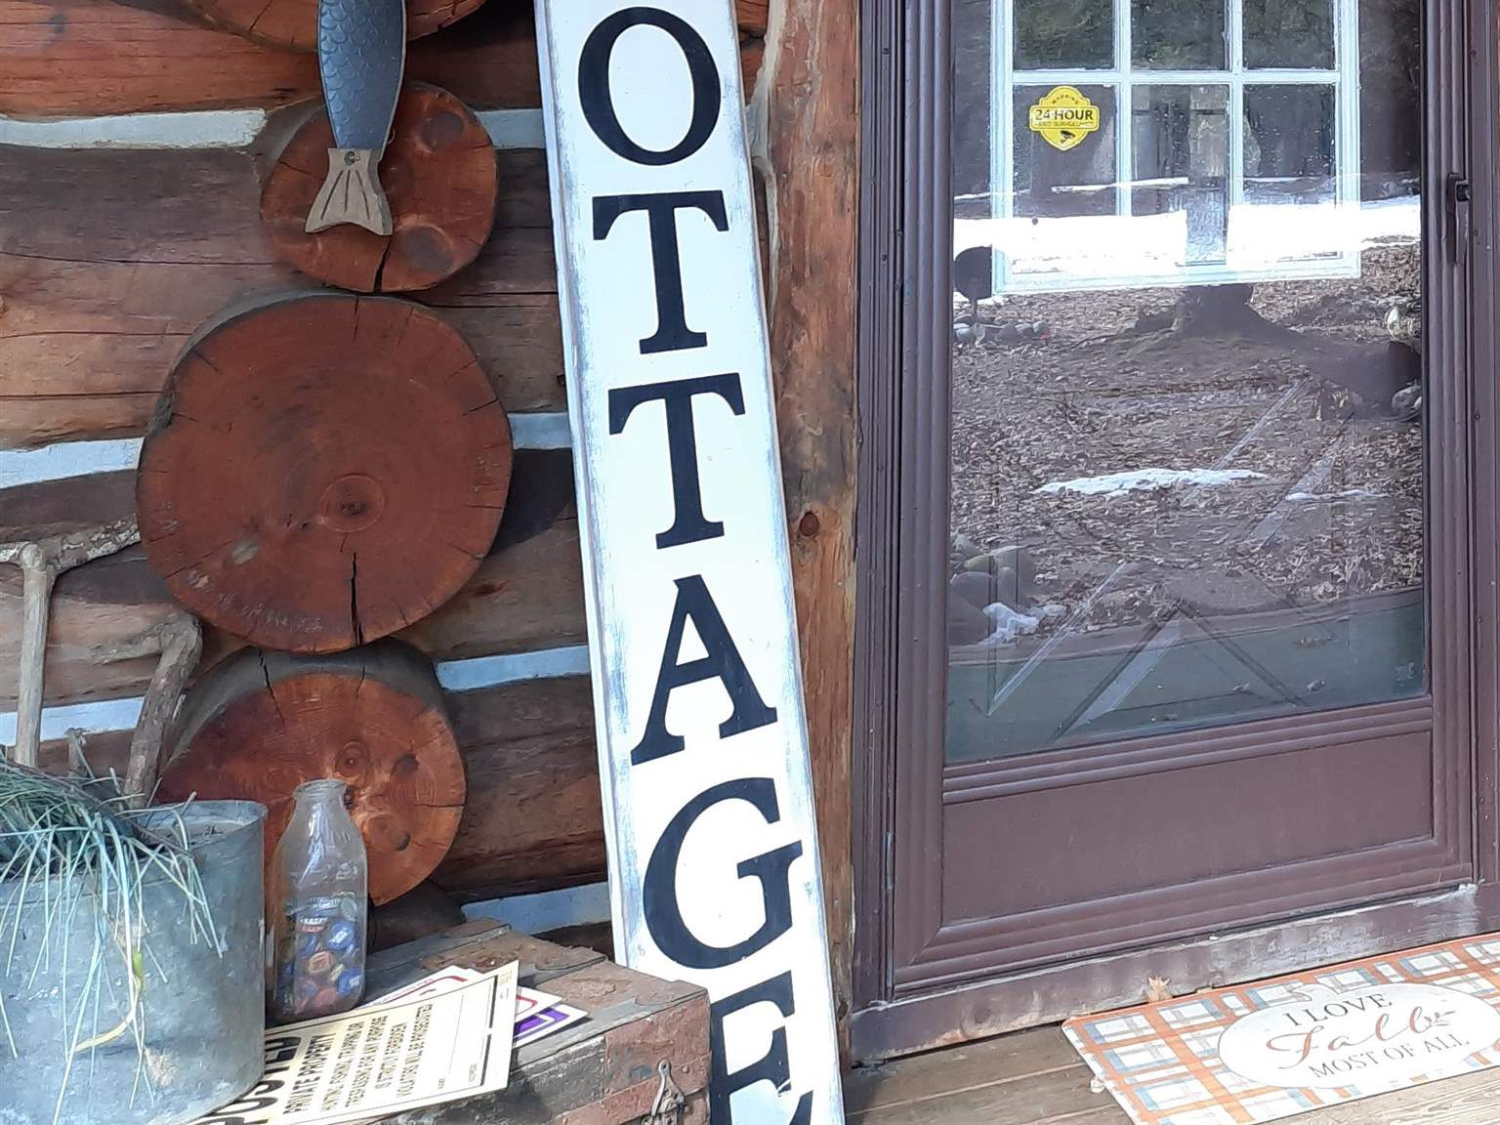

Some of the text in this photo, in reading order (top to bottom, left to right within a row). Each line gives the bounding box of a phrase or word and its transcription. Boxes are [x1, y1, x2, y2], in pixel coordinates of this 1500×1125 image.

[1035, 109, 1094, 121] 24 HOUR
[1284, 993, 1393, 1026] I LOVE
[1266, 1006, 1432, 1069] Fall
[1309, 1033, 1470, 1078] MOST OF ALL
[283, 1032, 337, 1115] PRIVATE PROPERTY
